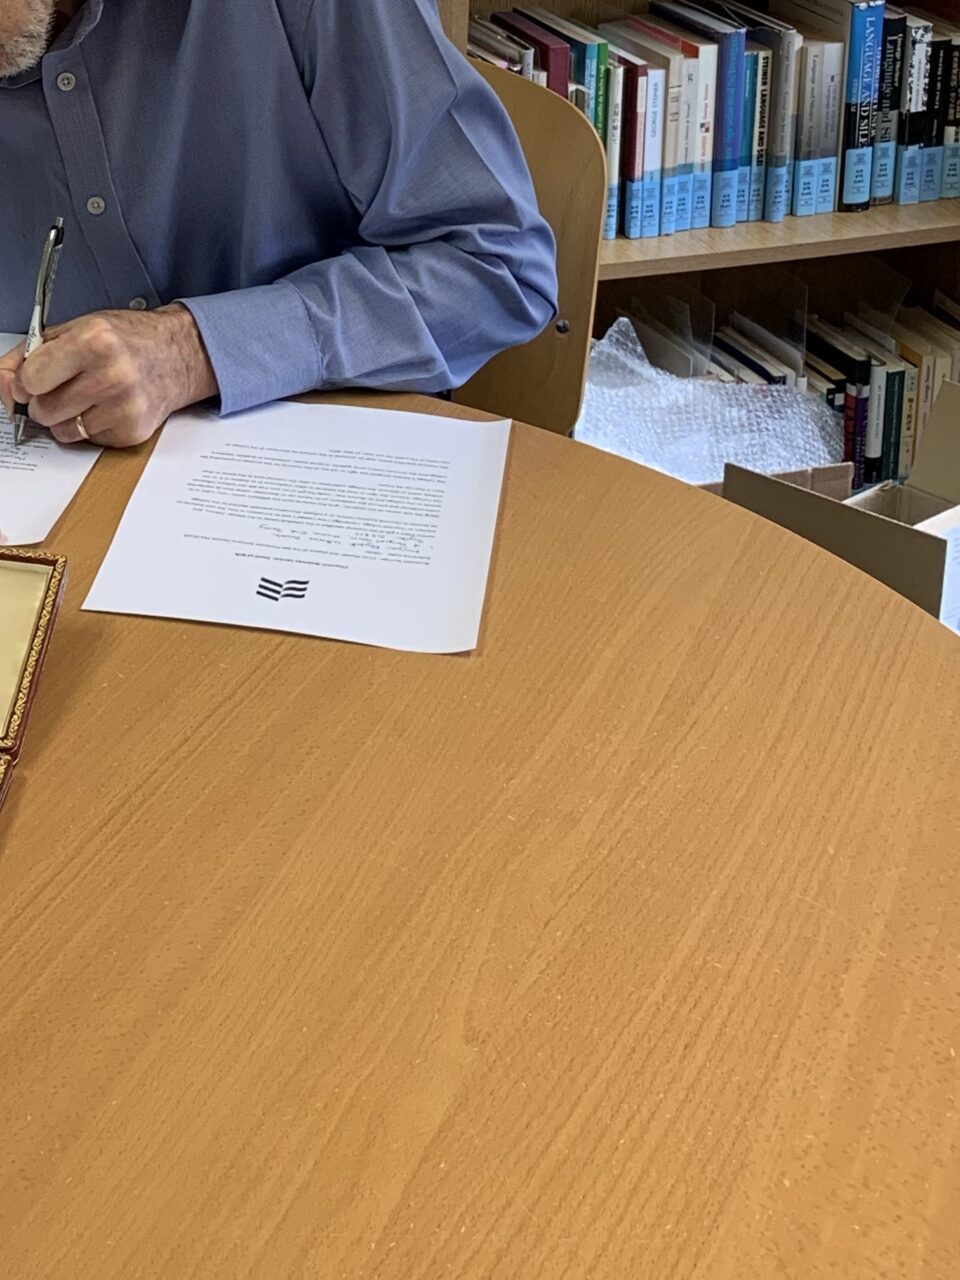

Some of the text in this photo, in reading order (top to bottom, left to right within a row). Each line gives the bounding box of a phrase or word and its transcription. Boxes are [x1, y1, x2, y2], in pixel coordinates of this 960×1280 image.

[811, 55, 819, 84] Language
[863, 17, 875, 81] LANGUAGE
[895, 33, 903, 60] George
[860, 87, 871, 116] AND
[880, 35, 898, 141] Language and Sil
[756, 56, 769, 167] STEINER LANGUAGE AND SILE
